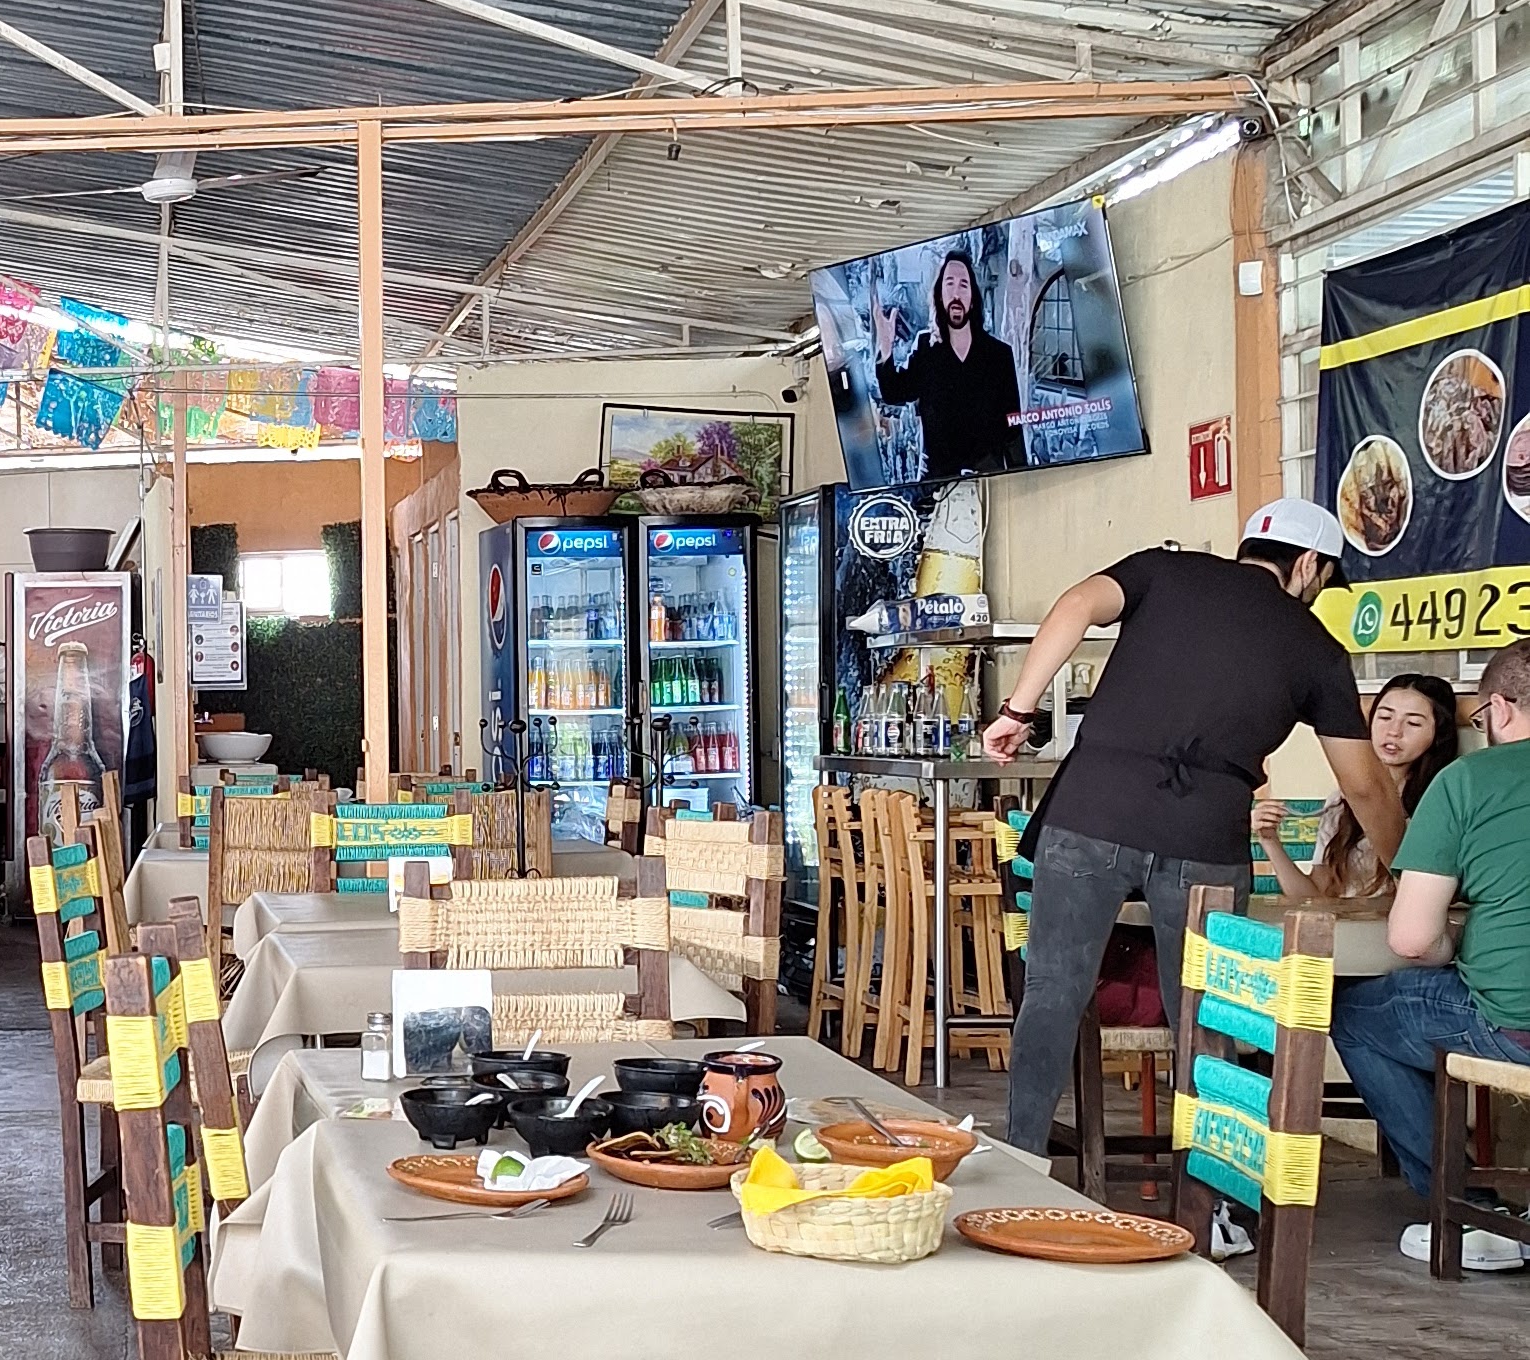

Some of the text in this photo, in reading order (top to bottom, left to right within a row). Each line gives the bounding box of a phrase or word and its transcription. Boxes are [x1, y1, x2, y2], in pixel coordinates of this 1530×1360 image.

[1007, 412, 1040, 427] MARCO
[1041, 405, 1083, 421] ANTONIO
[1083, 398, 1112, 415] SOLÍS
[860, 516, 910, 531] EXTRA
[562, 534, 607, 552] pepsi
[676, 533, 716, 550] pepsi
[864, 530, 904, 544] FRIA
[915, 598, 965, 616] Pétalo
[29, 593, 118, 647] Victoria
[969, 613, 988, 623] 420
